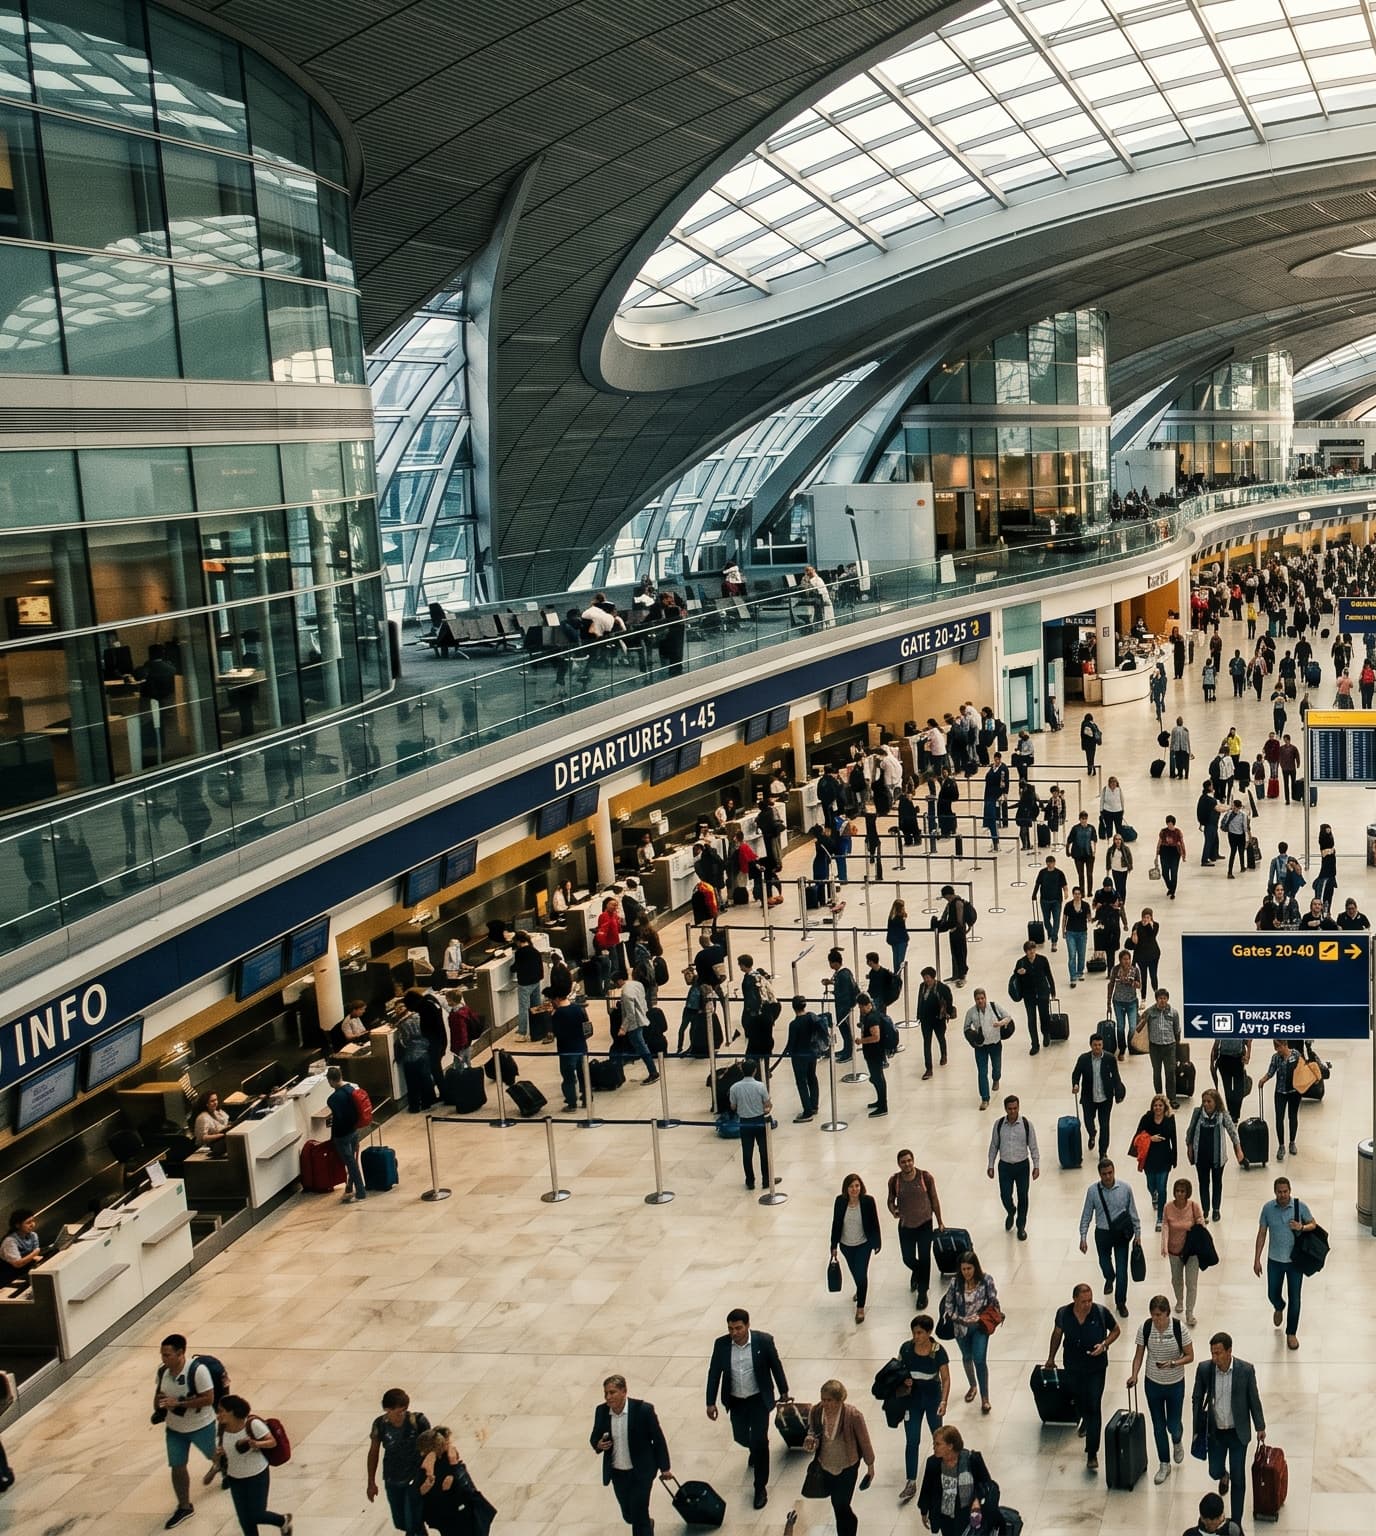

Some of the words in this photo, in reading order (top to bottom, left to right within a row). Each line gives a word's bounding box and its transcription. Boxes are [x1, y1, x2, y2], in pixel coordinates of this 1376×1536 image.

[901, 631, 931, 657] GATE
[935, 622, 967, 648] 20-25
[554, 717, 673, 791] DEPARTURES
[680, 702, 716, 737] 1-45
[1232, 944, 1272, 957] Gates
[1275, 944, 1315, 957] 20-40
[14, 983, 107, 1066] INFO
